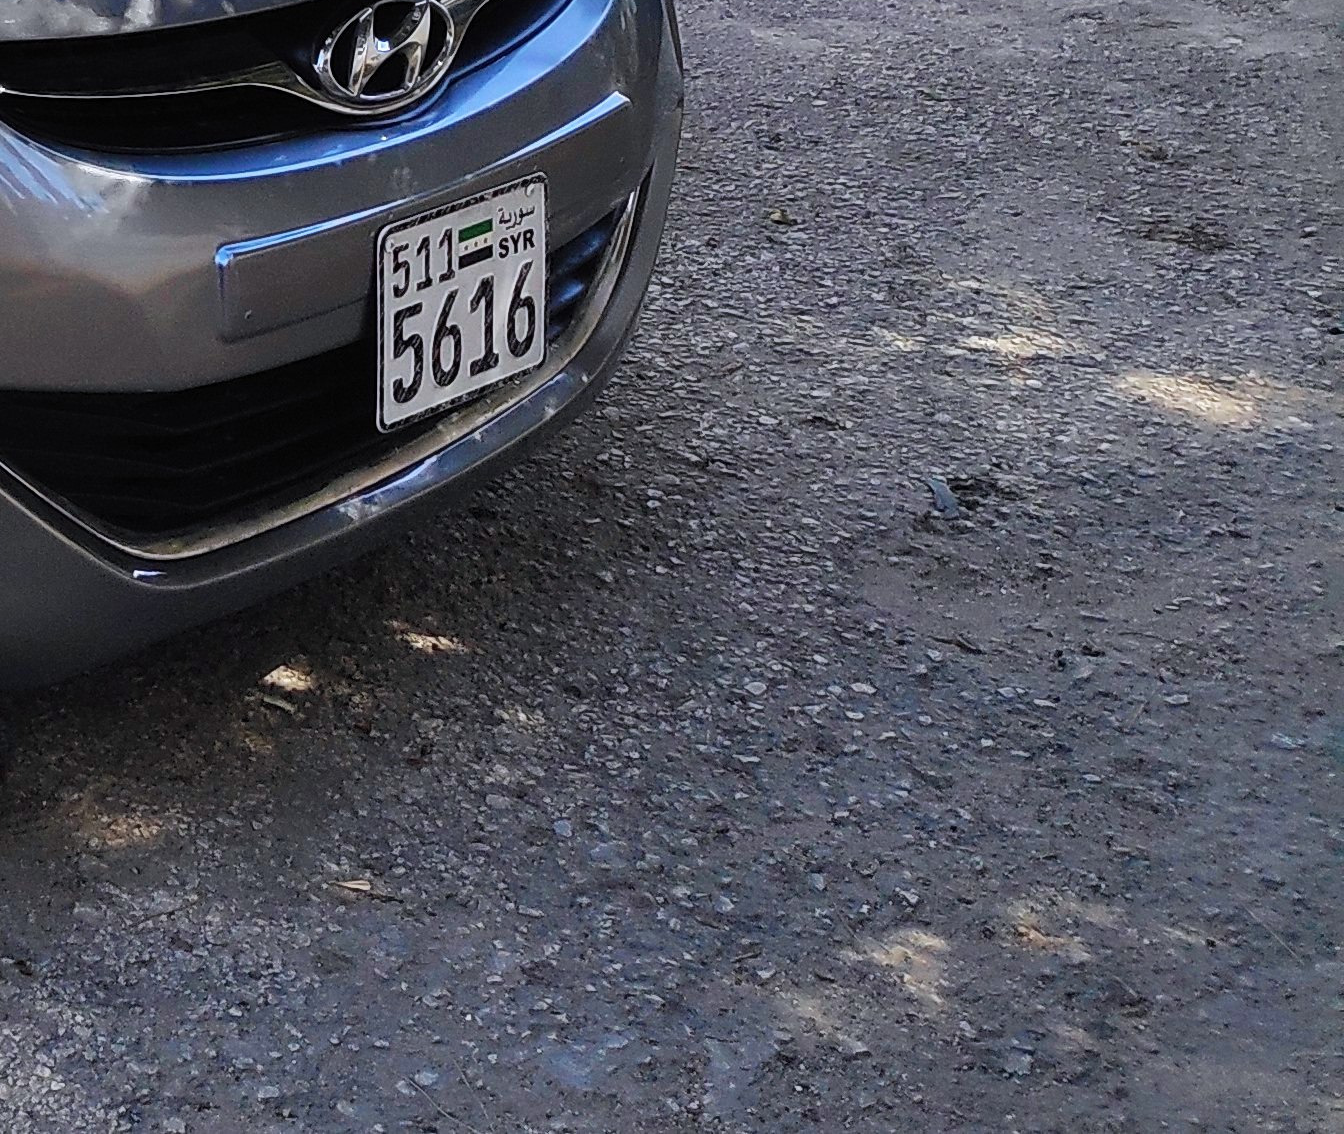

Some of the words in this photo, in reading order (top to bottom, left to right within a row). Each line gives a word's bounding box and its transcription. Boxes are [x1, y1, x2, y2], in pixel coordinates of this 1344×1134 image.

[497, 204, 536, 230] سورية
[392, 227, 456, 299] 511
[497, 227, 536, 260] SYR
[392, 258, 537, 404] 5616
